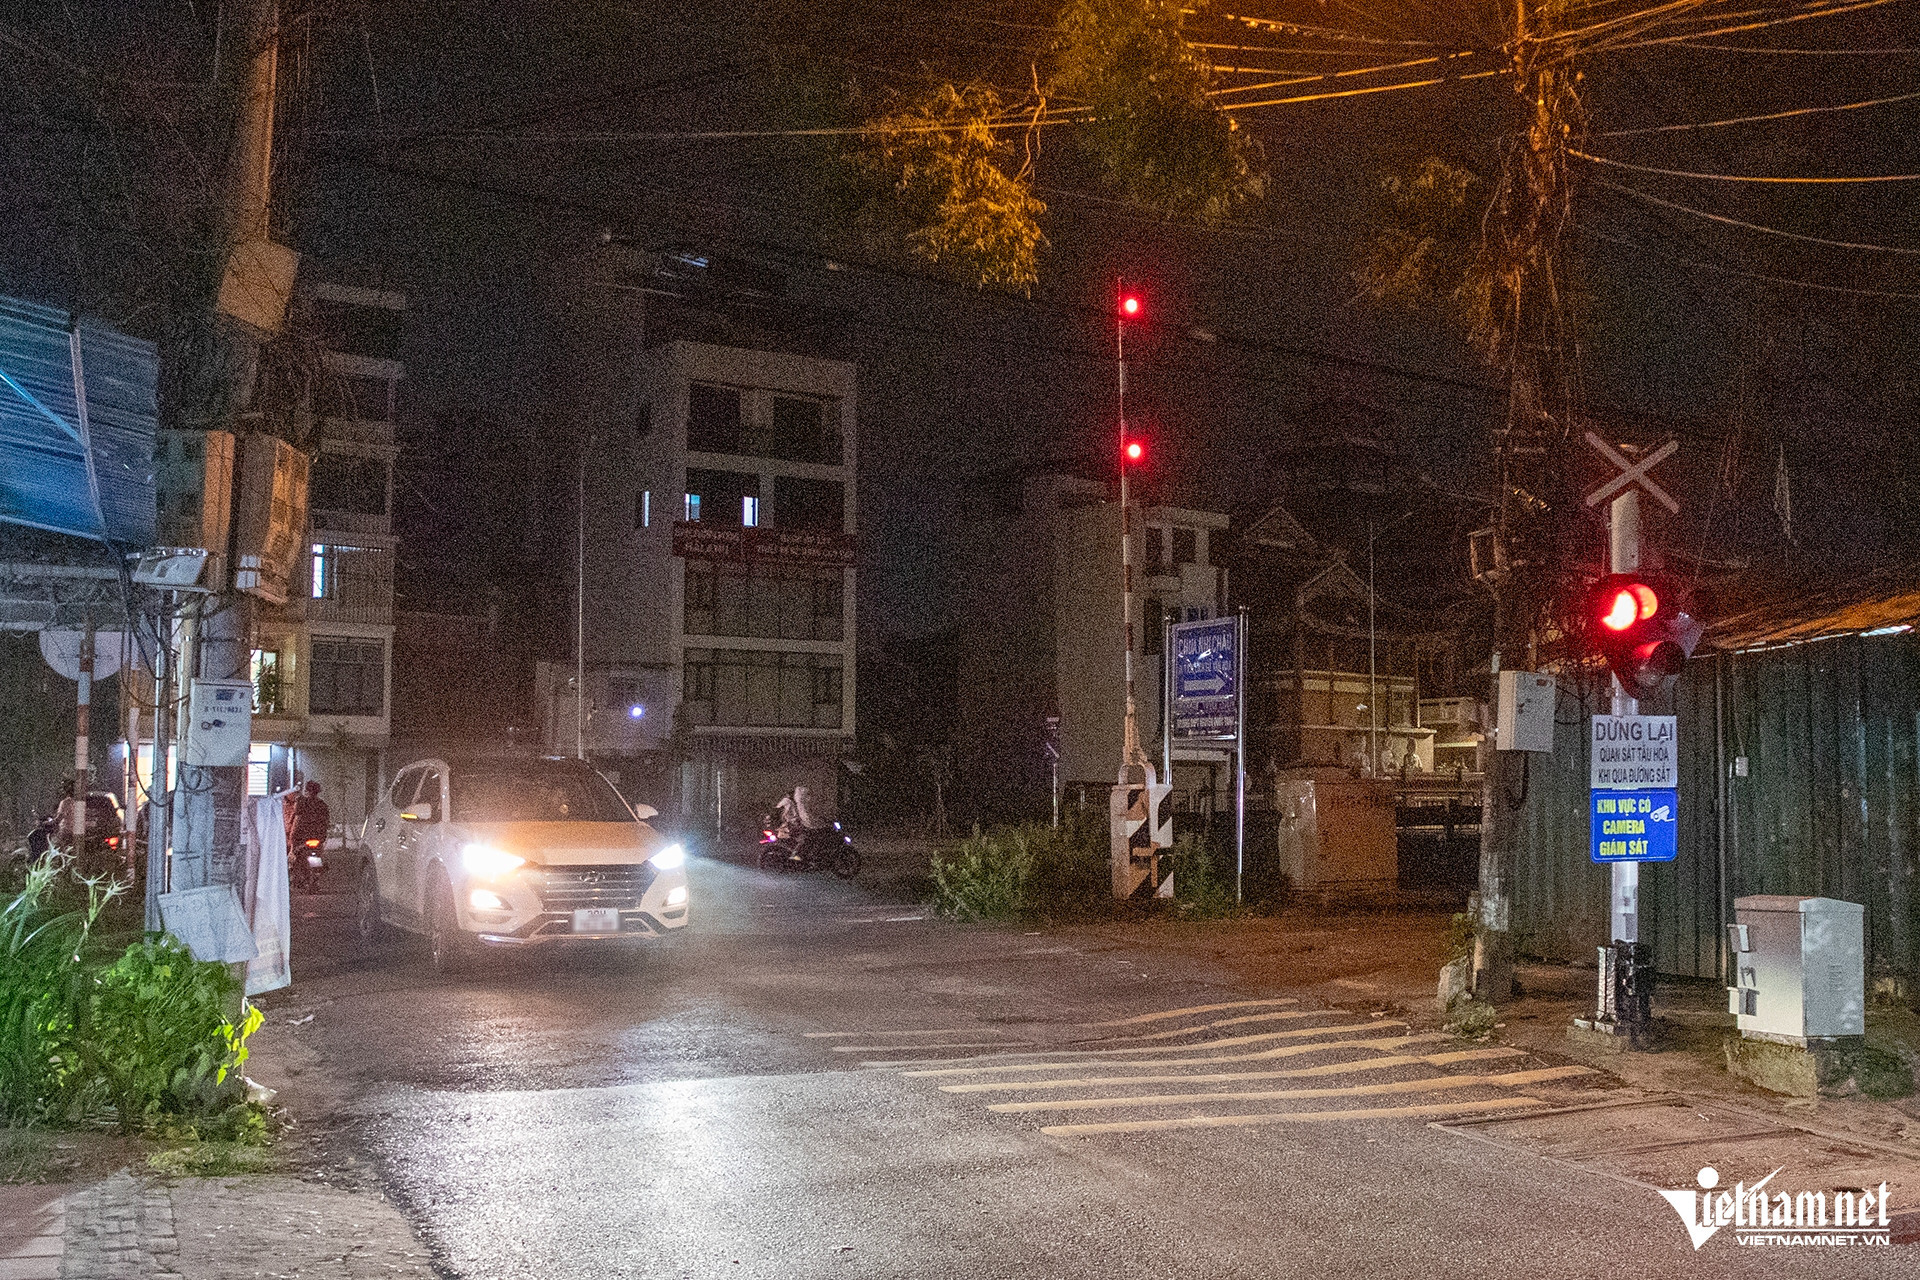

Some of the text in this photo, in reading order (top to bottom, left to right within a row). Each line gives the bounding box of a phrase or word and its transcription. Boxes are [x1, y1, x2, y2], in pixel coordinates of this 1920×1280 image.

[1596, 719, 1642, 741] DỪNG
[1599, 768, 1610, 782] KHI
[1612, 768, 1628, 783] QUA
[1597, 796, 1651, 816] KHU VỰC CÓ
[1603, 820, 1645, 834] CAMERA
[1600, 837, 1648, 856] GIÁM SÁT
